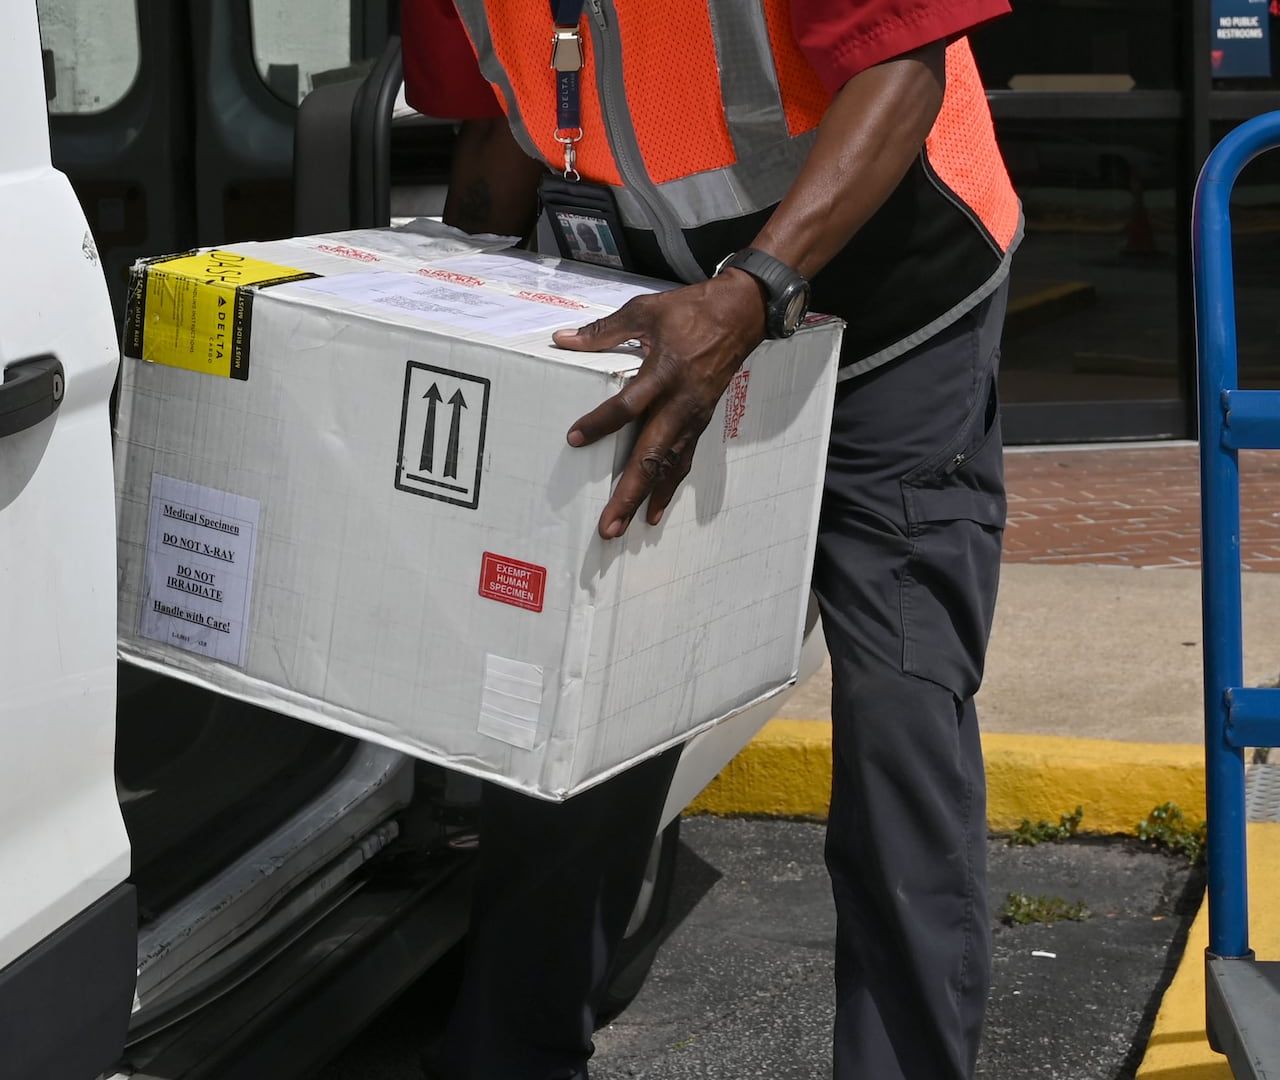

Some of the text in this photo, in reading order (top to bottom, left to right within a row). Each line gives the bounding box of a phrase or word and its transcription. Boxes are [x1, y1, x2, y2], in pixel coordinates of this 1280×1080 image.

[1220, 16, 1259, 27] NO PUBLIC
[1217, 28, 1263, 39] RESTROOMS
[204, 252, 245, 285] DASH
[216, 312, 226, 359] DELTA
[235, 347, 243, 369] MUST
[163, 504, 240, 535] Medical Specimen
[163, 532, 235, 561] DO NOT X-RAY
[177, 565, 216, 584] DO NOT
[496, 563, 532, 580] EXEMPT
[497, 573, 529, 589] HUMAN
[167, 576, 224, 600] IRRADIATE
[489, 581, 534, 601] SPECIMEN
[153, 600, 231, 632] Handle with Care!
